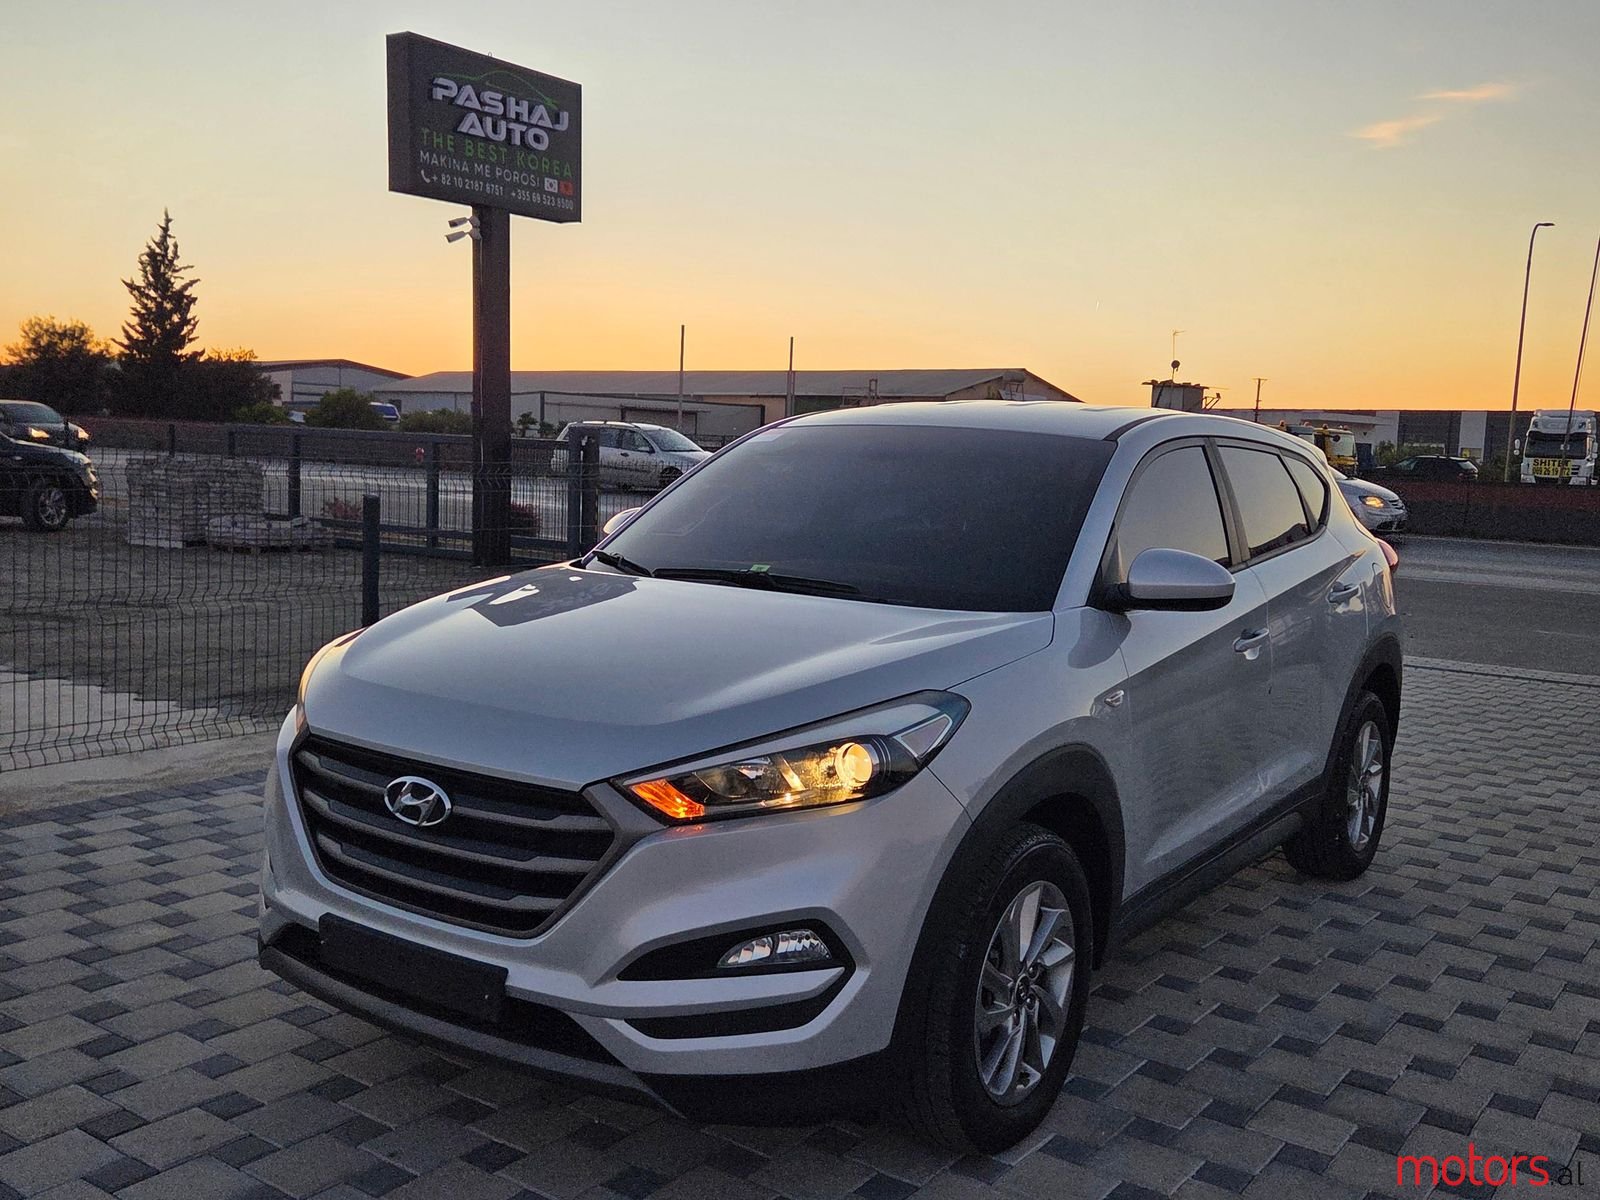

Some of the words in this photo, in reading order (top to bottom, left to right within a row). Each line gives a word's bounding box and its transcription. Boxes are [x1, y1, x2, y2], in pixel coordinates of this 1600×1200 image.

[431, 77, 569, 133] PASHAJ
[456, 111, 549, 151] AUTO
[419, 150, 470, 173] MAKINA
[474, 163, 491, 178] ME
[495, 167, 540, 188] POROSI
[421, 127, 455, 152] THE
[464, 139, 507, 164] BEST
[516, 151, 572, 177] KOREA
[441, 174, 451, 184] 82
[453, 177, 463, 188] 10
[465, 179, 484, 191] 2187
[486, 182, 504, 195] 8751
[510, 187, 531, 201] +355
